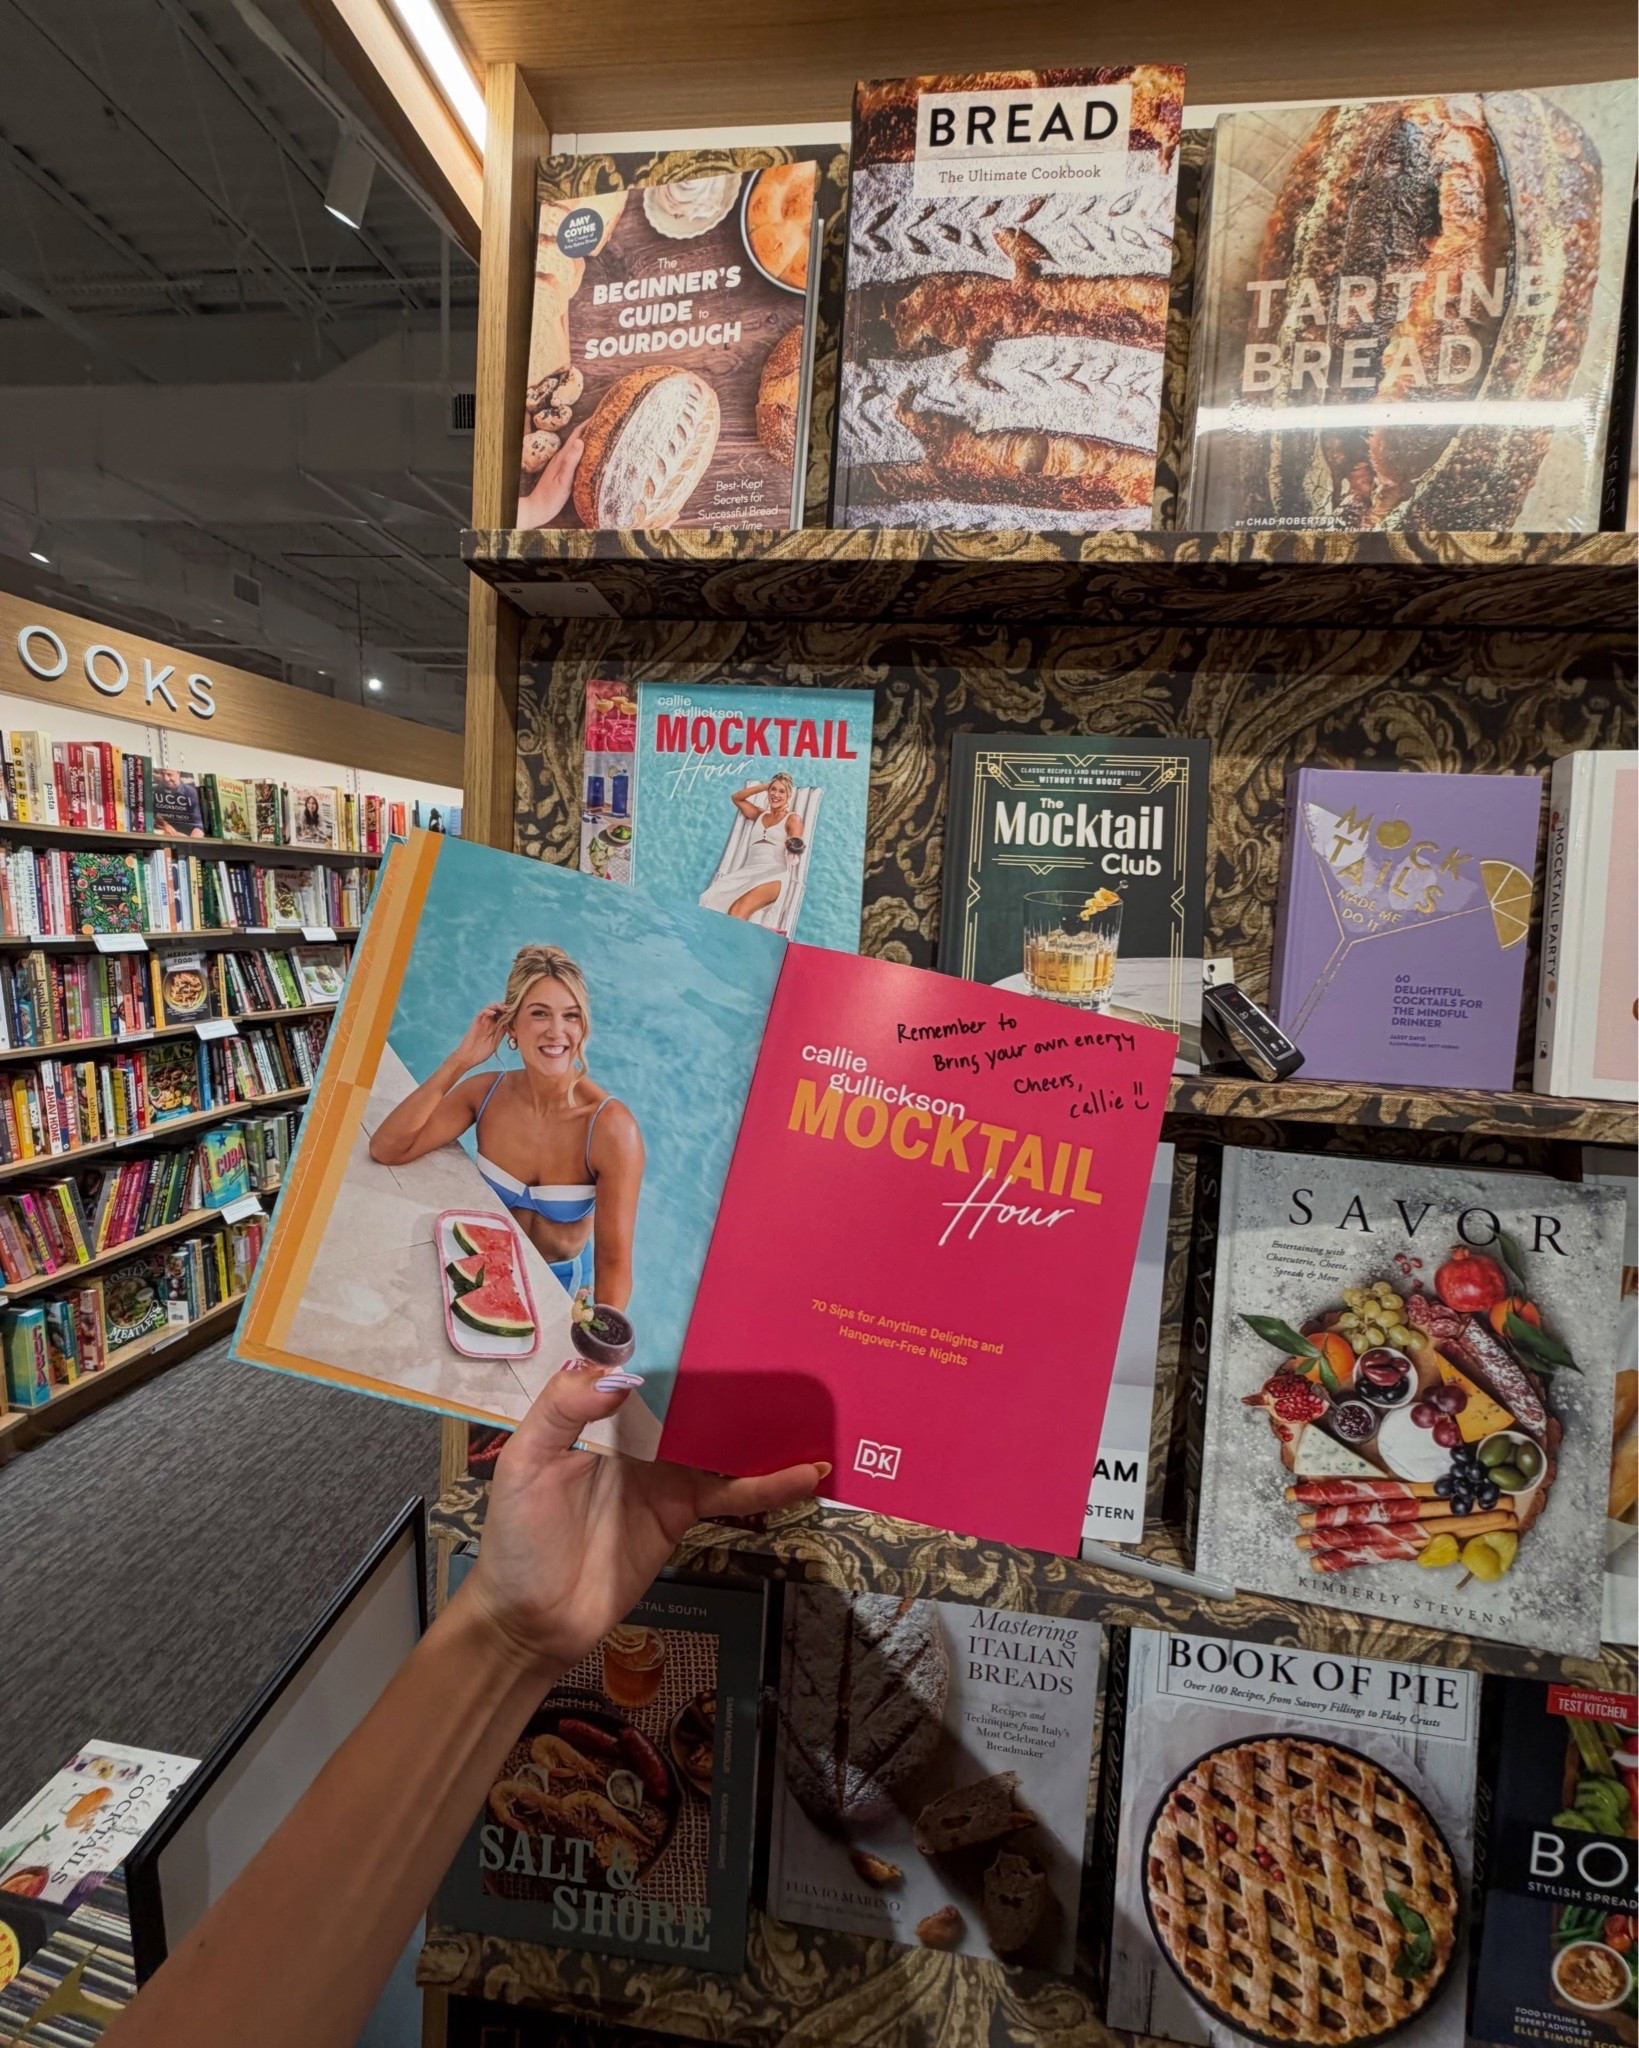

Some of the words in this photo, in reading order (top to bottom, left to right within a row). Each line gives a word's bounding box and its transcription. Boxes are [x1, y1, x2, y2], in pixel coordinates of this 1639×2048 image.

[929, 100, 1119, 147] BREAD
[938, 171, 964, 183] The
[968, 168, 1027, 182] Ultimate
[1031, 165, 1101, 180] Cookbook
[564, 222, 596, 238] COYNE
[569, 214, 591, 229] AMY
[657, 257, 678, 270] The
[592, 265, 742, 306] BEGINNER'S
[1246, 265, 1556, 329] TARTINE
[618, 299, 693, 328] GUIDE
[699, 309, 709, 319] to
[584, 321, 742, 360] SOURDOUGH
[1241, 333, 1483, 393] BREAD
[713, 494, 748, 505] Secrets
[750, 491, 764, 502] for
[716, 478, 764, 491] Best-Kept
[698, 506, 748, 520] Successful
[749, 504, 779, 516] Bread
[741, 520, 763, 530] Time
[1246, 517, 1276, 526] CHAD
[1279, 516, 1346, 526] ROBERTSON
[657, 694, 692, 707] callie
[673, 706, 743, 719] gullickson
[654, 714, 858, 760] MOCKTAIL
[666, 743, 755, 800] Hour
[1038, 776, 1076, 784] WITHOUT
[1078, 777, 1094, 785] THE
[1096, 777, 1122, 786] BOOZE
[1106, 769, 1141, 777] FAVORITES)
[44, 782, 55, 810] pasta
[154, 793, 192, 806] UCCI
[1040, 797, 1064, 809] The
[994, 800, 1164, 850] Mocktail
[1101, 853, 1162, 876] Club
[1329, 834, 1445, 916] TAILS
[1551, 827, 1566, 918] MOCKTAIL
[27, 865, 35, 896] LEBANESE
[1336, 889, 1379, 914] MADE
[1379, 904, 1403, 925] ME
[1342, 908, 1364, 926] DO
[1367, 917, 1381, 933] IT
[1547, 923, 1559, 977] PARTY
[107, 957, 116, 988] JEWISH
[1394, 974, 1411, 983] 60
[37, 979, 49, 1007] Israeli
[1393, 995, 1457, 1008] COCKTAILS
[1459, 999, 1484, 1009] FOR
[1394, 985, 1465, 997] DELIGHTFUL
[40, 1008, 51, 1030] Soul
[1391, 1017, 1442, 1028] DRINKER
[1393, 1006, 1415, 1016] THE
[1416, 1008, 1469, 1019] MINDFUL
[897, 1018, 987, 1043] Remember
[998, 1013, 1018, 1032] to
[801, 1044, 868, 1074] callie
[933, 1052, 979, 1074] Bring
[985, 1044, 1028, 1070] your
[1033, 1036, 1068, 1054] own
[1074, 1032, 1136, 1051] energy
[45, 1085, 57, 1115] ZAHAV
[829, 1071, 966, 1121] gullickson
[65, 1095, 76, 1134] SHABBAT
[49, 1116, 60, 1143] HOME
[787, 1078, 1102, 1205] MOCKTAIL
[149, 1160, 160, 1184] ARNIE
[198, 1144, 213, 1193] CUBA
[216, 1142, 246, 1178] CUBA
[938, 1168, 1075, 1247] Hour
[1288, 1188, 1570, 1257] SAVOR
[1266, 1252, 1316, 1267] Charcuterie,
[1318, 1258, 1349, 1272] Cheese,
[1271, 1239, 1324, 1257] Entertaining
[1324, 1246, 1346, 1257] with
[1272, 1266, 1305, 1281] Spreads
[1306, 1268, 1316, 1279] &
[1318, 1272, 1340, 1283] More
[1193, 1176, 1218, 1406] SAVOR
[811, 1299, 827, 1312] 70
[829, 1302, 855, 1321] Sips
[857, 1310, 875, 1324] for
[877, 1314, 928, 1338] Anytime
[930, 1327, 979, 1350] Delights
[980, 1340, 1004, 1355] and
[32, 1324, 47, 1387] CUBA
[838, 1325, 927, 1356] Hangover-Free
[929, 1346, 968, 1367] Nights
[860, 1447, 895, 1472] DK
[634, 1601, 665, 1612] STAL
[667, 1604, 708, 1617] SOUTH
[1297, 1576, 1401, 1606] KIMBERLY
[1413, 1598, 1509, 1628] STEVENS
[970, 1608, 1079, 1649] Mastering
[968, 1635, 1077, 1670] ITALIAN
[967, 1661, 1073, 1696] BREADS
[1168, 1638, 1298, 1686] BOOK
[1312, 1660, 1373, 1696] OF
[1387, 1670, 1460, 1710] PIE
[1183, 1679, 1206, 1691] Over
[1209, 1683, 1228, 1695] 100
[1230, 1686, 1266, 1702] Recipes,
[1266, 1692, 1292, 1706] from
[1294, 1696, 1328, 1713] Savory
[1329, 1702, 1365, 1718] Fillings
[1368, 1708, 1378, 1718] to
[1380, 1709, 1407, 1724] Flaky
[1409, 1714, 1441, 1728] Crusts
[1558, 1698, 1583, 1713] TEST
[1584, 1701, 1628, 1720] KITCHEN
[1571, 1691, 1616, 1705] AMERICA'S
[964, 1712, 1018, 1730] Techniques
[1018, 1722, 1039, 1733] from
[1042, 1725, 1070, 1739] Italy's
[991, 1704, 1027, 1719] Recipes
[1029, 1712, 1047, 1721] and
[976, 1726, 1001, 1738] Most
[1003, 1732, 1056, 1748] Celebrated
[986, 1740, 1044, 1759] Breadmaker
[51, 1774, 156, 1886] COCKTAILS
[478, 1823, 595, 1884] SALT
[606, 1843, 641, 1892] &
[1530, 1830, 1639, 1893] BO
[786, 1881, 838, 1899] FULVIO
[841, 1892, 901, 1912] MARINO
[1528, 1881, 1581, 1899] STYLISH
[552, 1884, 712, 1953] SHORE
[1514, 2016, 1545, 2027] EXPERT
[1547, 2022, 1579, 2035] ADVICE
[1581, 2029, 1593, 2037] BY
[1515, 2006, 1541, 2017] FOOD
[1542, 2012, 1578, 2025] STYLING
[1513, 2025, 1540, 2038] ELLE
[1543, 2031, 1590, 2047] SIMONE
